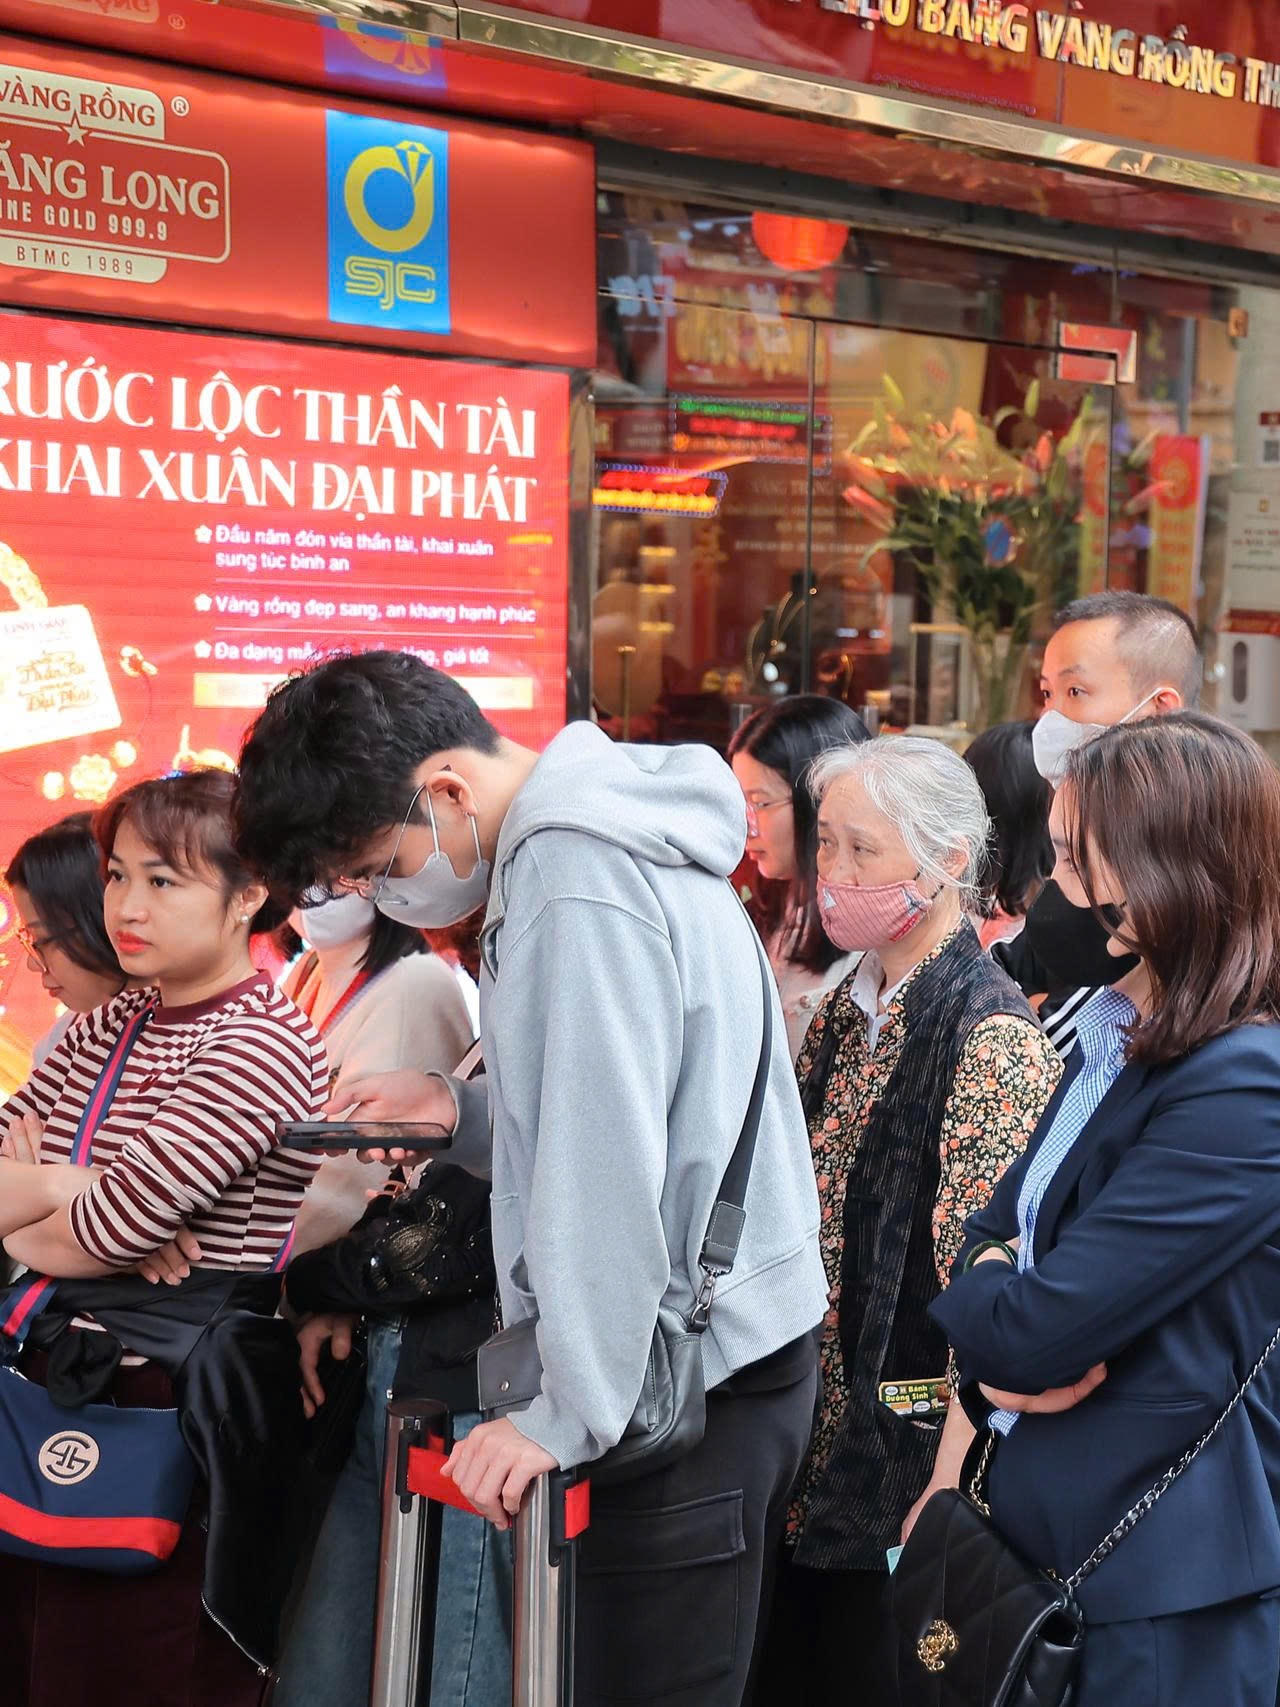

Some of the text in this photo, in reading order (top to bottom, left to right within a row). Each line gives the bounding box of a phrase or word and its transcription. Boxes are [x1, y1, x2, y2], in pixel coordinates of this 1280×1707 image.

[1138, 24, 1236, 97] RỒNG
[79, 87, 156, 127] RỒNG
[101, 165, 220, 220] LONG
[44, 205, 97, 231] GOLD
[108, 214, 168, 241] 999.9
[17, 246, 133, 275] BTMC 1989
[171, 369, 282, 442] LỘC
[293, 384, 447, 449] THẦN
[456, 396, 536, 458] TÀI
[137, 446, 297, 508] XUÂN
[311, 462, 395, 521] ĐẠI
[410, 464, 538, 522] PHÁT
[215, 525, 250, 545] Đầu
[255, 529, 291, 546] năm
[295, 529, 326, 548] đón
[356, 530, 392, 551] thần
[422, 536, 454, 555] khai
[457, 537, 494, 556] xuân
[215, 554, 257, 572] sung
[261, 552, 287, 570] túc
[328, 558, 350, 571] an
[215, 595, 259, 616] Vàng
[386, 605, 406, 618] an
[409, 603, 456, 623] khang
[500, 605, 536, 624] phúc
[215, 642, 240, 659] Đa
